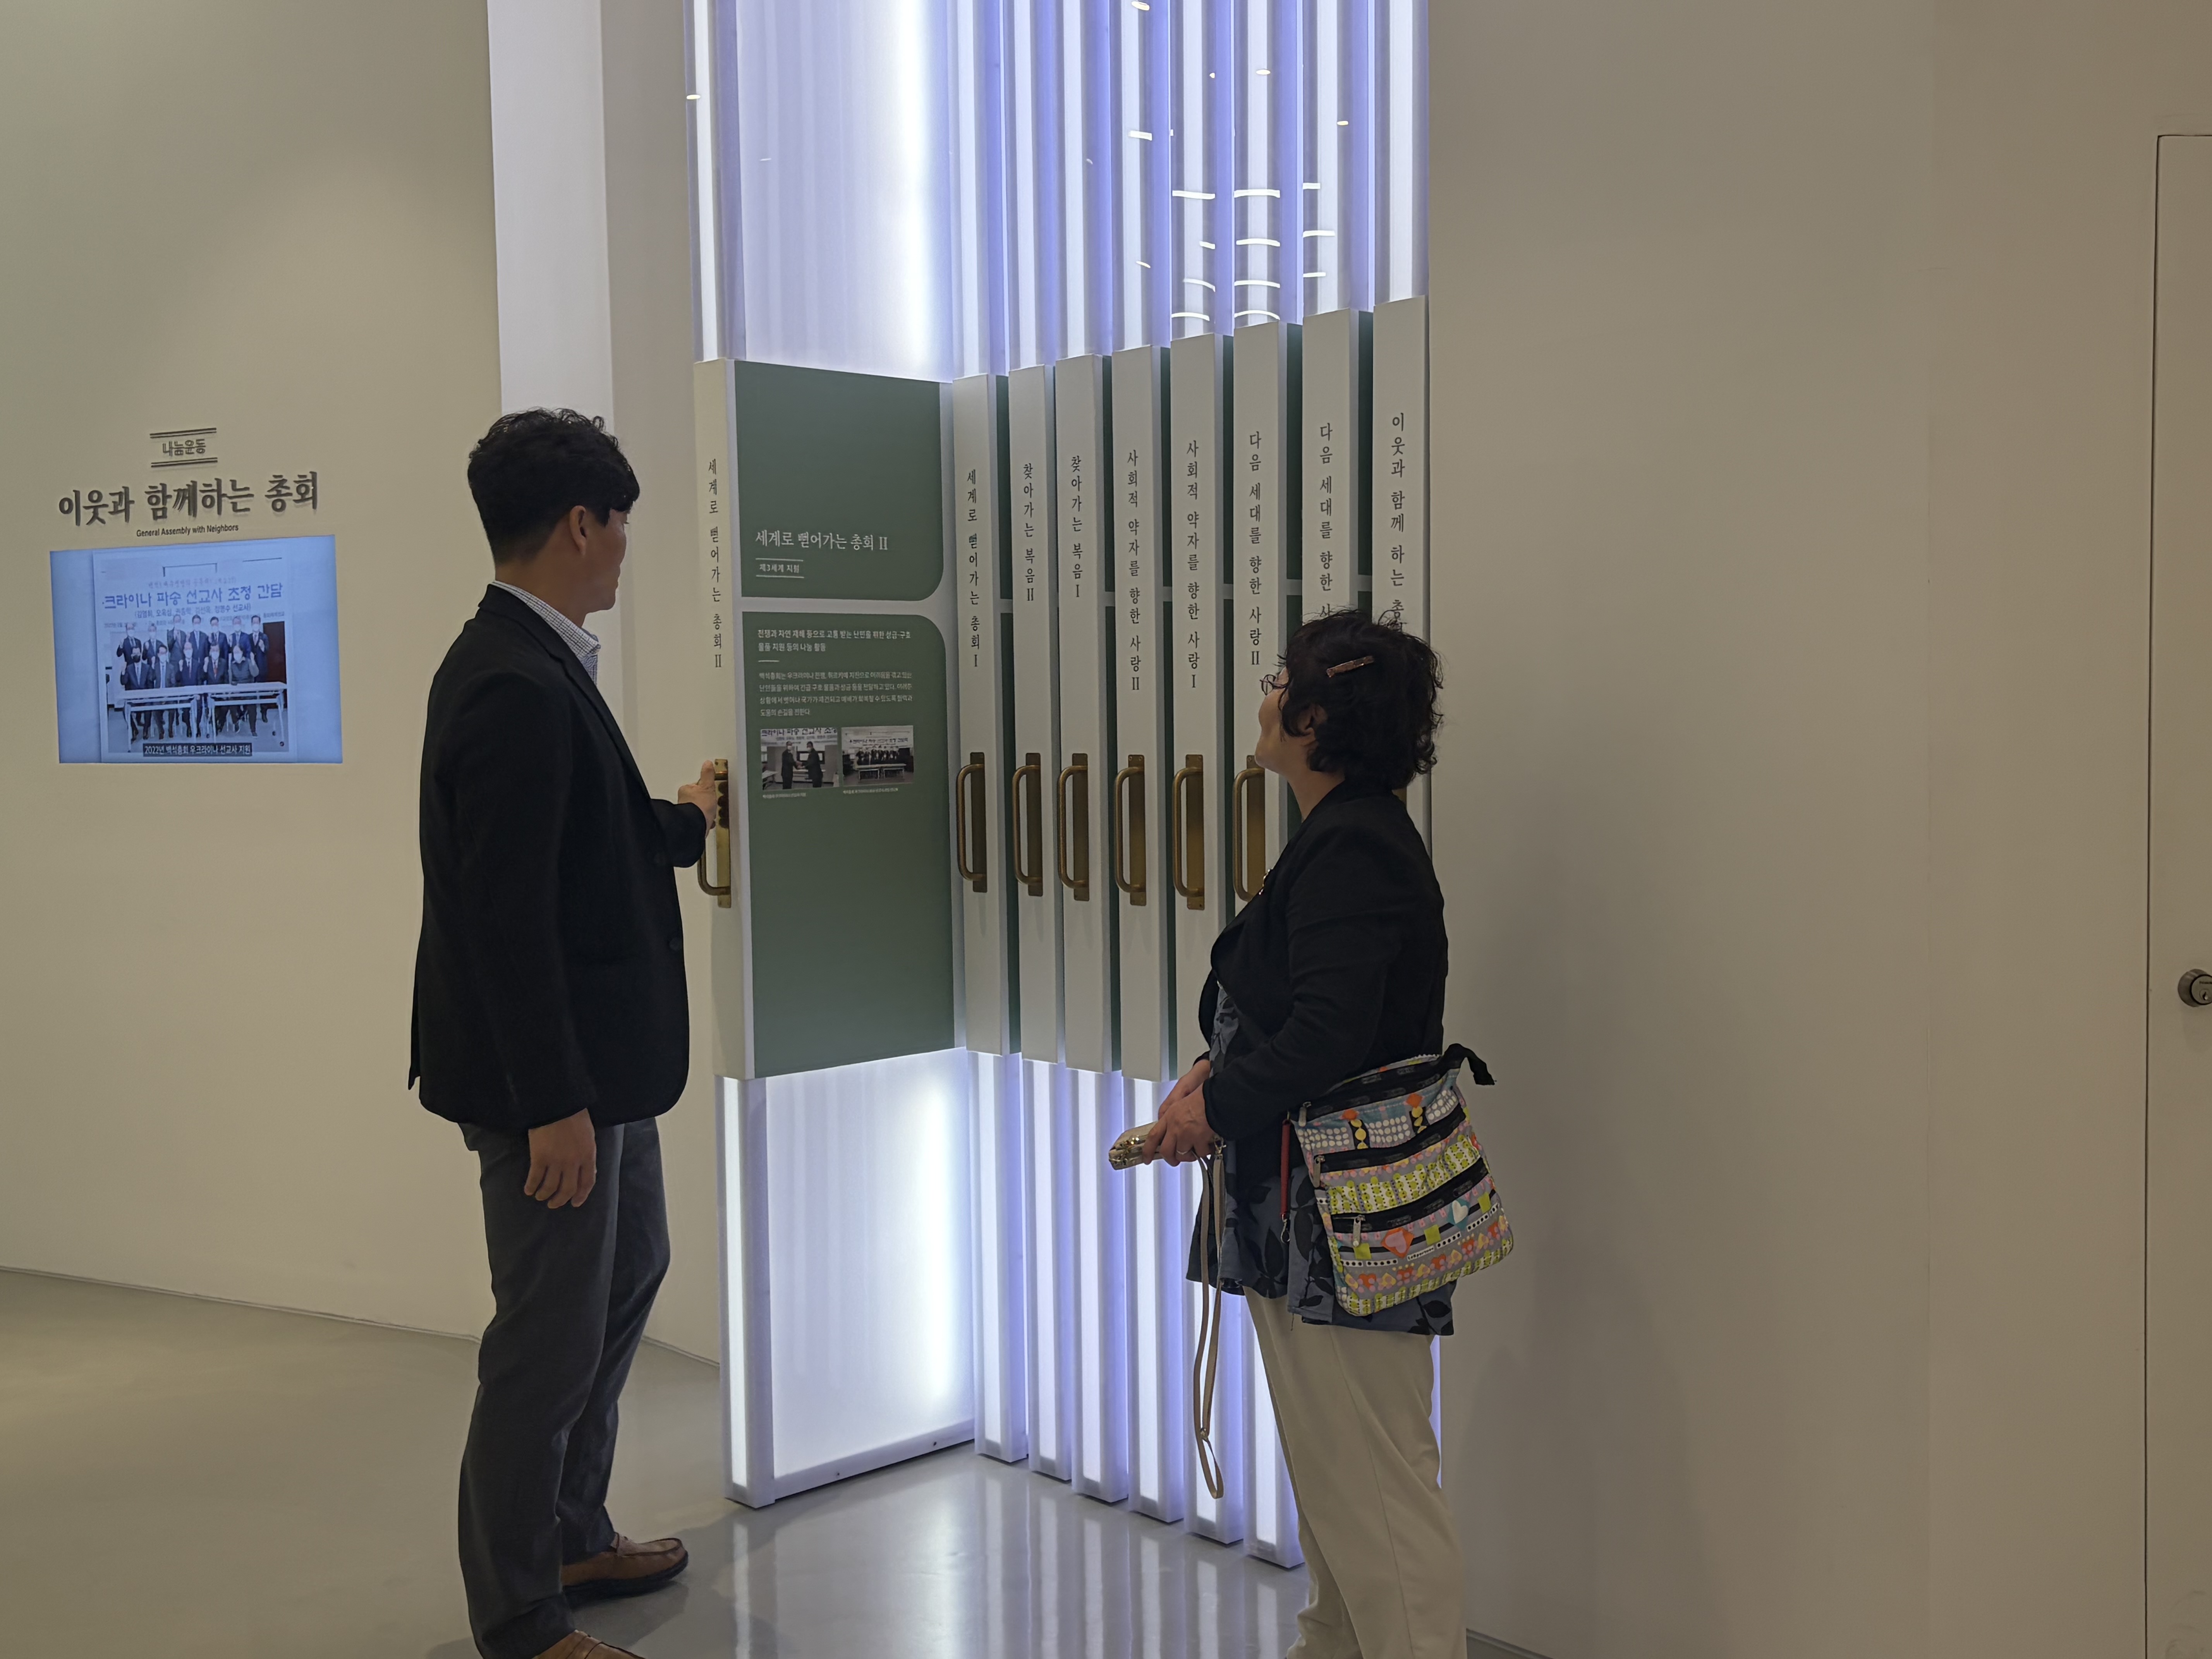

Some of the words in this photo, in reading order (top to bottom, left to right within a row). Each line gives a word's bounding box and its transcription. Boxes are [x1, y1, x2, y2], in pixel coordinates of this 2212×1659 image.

[1249, 431, 1263, 472] 다음
[1320, 422, 1334, 465] 다음
[1391, 412, 1406, 479] 이웃과
[708, 458, 720, 515] 세계로
[1127, 449, 1139, 509] 사회적
[1186, 440, 1200, 501] 사회적
[58, 486, 135, 526] 이웃과
[144, 478, 254, 521] 함께하는
[264, 471, 318, 513] 총회
[967, 469, 978, 522] 세계로
[1023, 463, 1035, 538] 찾아가는
[1071, 455, 1083, 533] 찾아가는
[1249, 482, 1262, 545] 세대를
[1319, 475, 1334, 540] 세대를
[1391, 490, 1406, 533] 함께
[136, 529, 160, 537] General
[161, 526, 191, 536] Assembly
[192, 525, 205, 534] with
[207, 524, 239, 534] Neighbors
[755, 529, 794, 547] 세계로
[798, 531, 847, 549] 뻗어가는
[850, 534, 874, 551] 총회
[1128, 519, 1141, 577] 약자를
[1187, 511, 1200, 572] 약자를
[710, 526, 722, 603] 뻗어가는
[759, 563, 784, 573] 제3세계
[969, 533, 980, 606] 뻗어가는
[1025, 548, 1036, 584] 복음
[1072, 543, 1084, 580] 복음
[1249, 555, 1263, 596] 향한
[1320, 550, 1334, 592] 향한
[157, 591, 182, 606] 파송
[187, 587, 223, 605] 선교사
[257, 582, 283, 599] 간담
[1129, 587, 1142, 625] 향한
[1187, 581, 1200, 621] 향한
[713, 613, 723, 650] 총회
[758, 629, 777, 638] 전쟁과
[778, 630, 791, 638] 자연
[854, 630, 871, 639] 난민을
[787, 643, 799, 651] 등의
[970, 615, 981, 651] 총회
[1249, 606, 1262, 647] 사랑
[1130, 635, 1142, 673] 사랑
[1187, 631, 1201, 670] 사랑
[220, 744, 237, 755] 선교사
